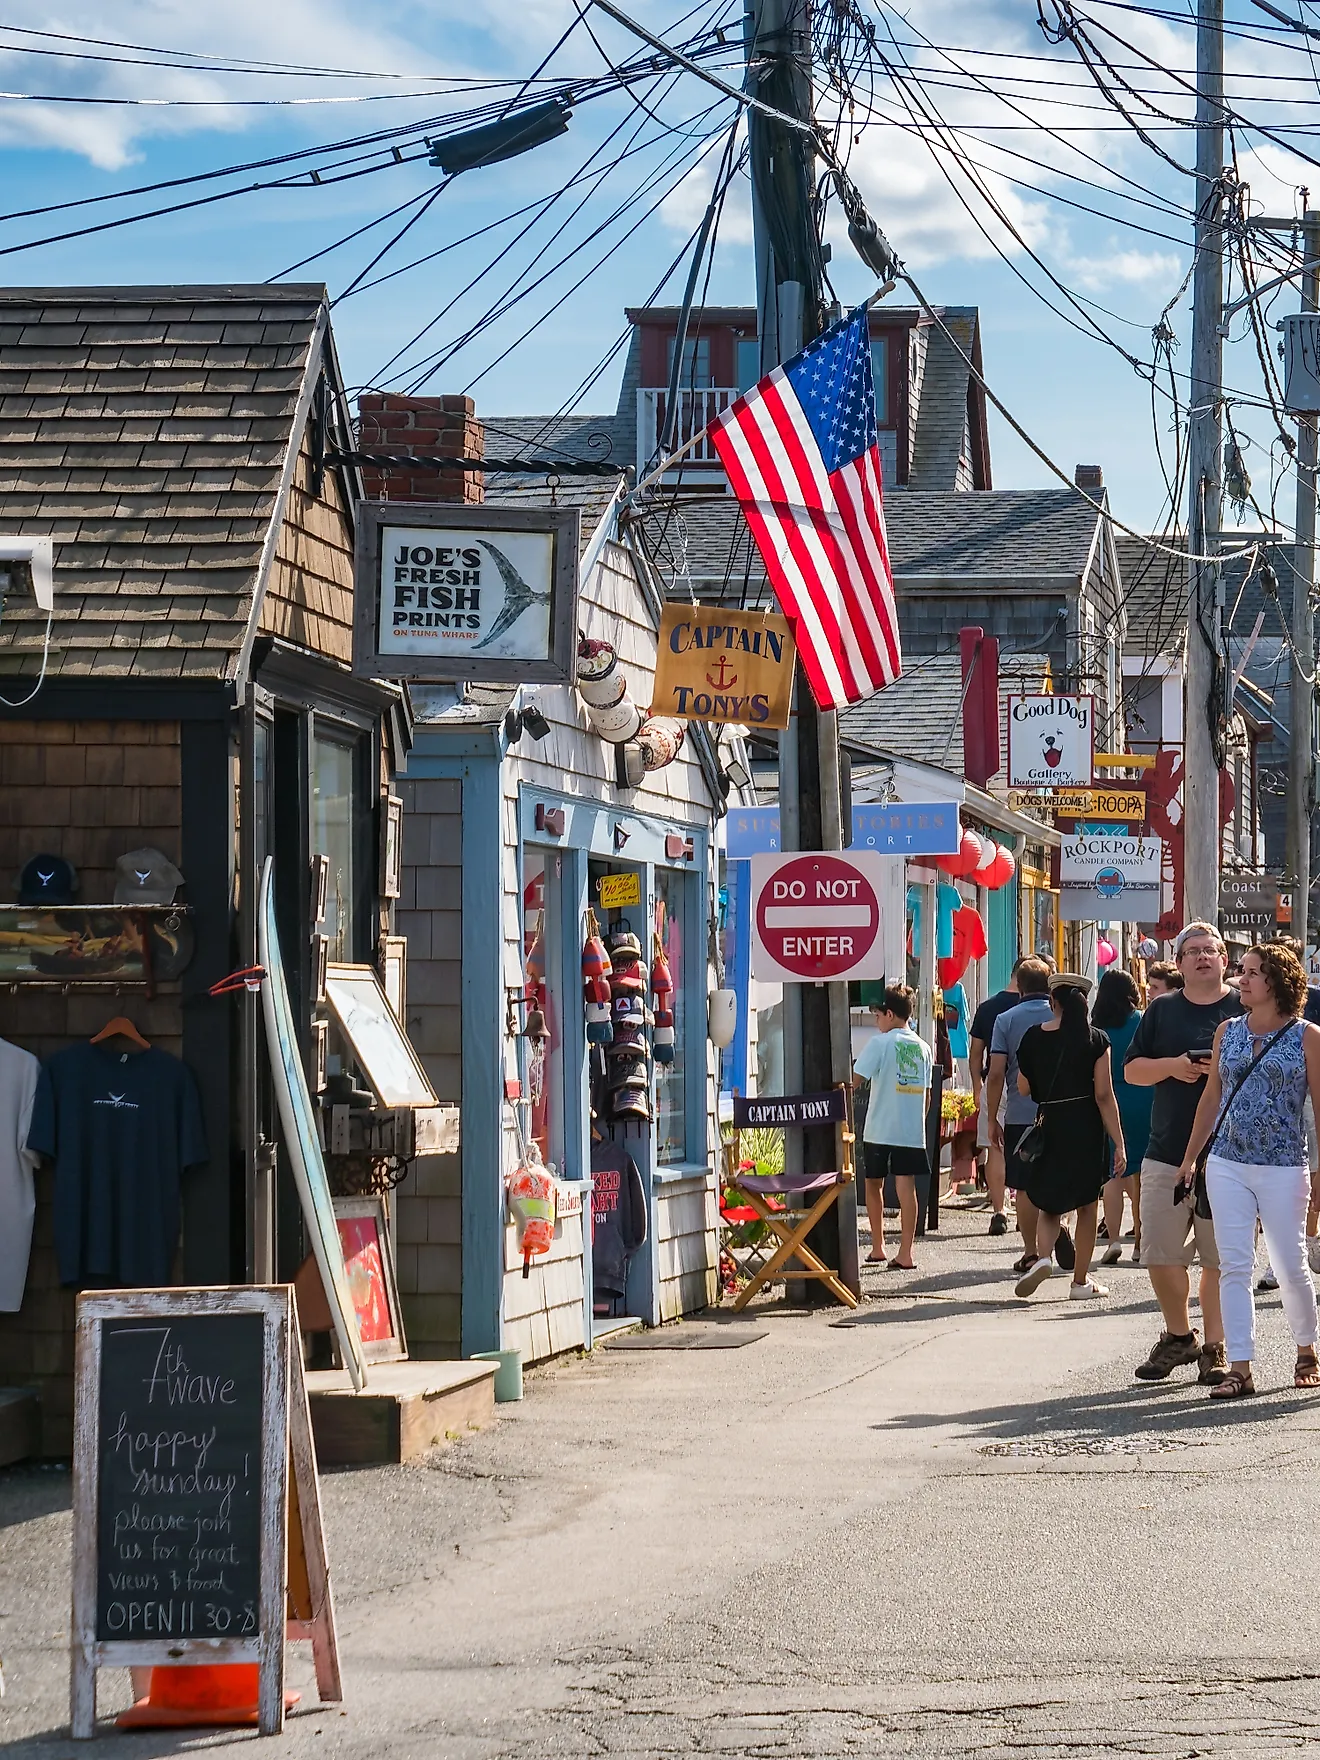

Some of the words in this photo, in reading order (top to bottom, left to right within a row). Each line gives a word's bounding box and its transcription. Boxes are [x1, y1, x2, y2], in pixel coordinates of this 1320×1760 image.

[394, 546, 481, 568] JOE'S
[394, 567, 480, 585] FRESH
[394, 586, 480, 610] FISH
[393, 612, 480, 629] PRINTS
[393, 629, 408, 637] ON
[442, 631, 479, 639] WHARF
[670, 622, 785, 663] CAPTAIN
[673, 686, 769, 722] TONY'S
[1013, 698, 1054, 721] Good
[1058, 698, 1088, 729] Dog
[1028, 768, 1072, 780] Gallery
[1016, 795, 1042, 806] DOGS
[1044, 796, 1087, 807] WELCOME!
[856, 814, 945, 831] TORIES
[1063, 840, 1160, 861] ROCKPORT
[1074, 857, 1106, 865] CANDLE
[1106, 858, 1145, 866] COMPANY
[773, 880, 806, 899] DO
[816, 879, 861, 898] NOT
[1221, 880, 1261, 893] Coast
[1235, 897, 1248, 909] &
[1283, 896, 1289, 906] 4
[1224, 913, 1272, 927] ountry
[782, 936, 854, 956] ENTER
[748, 1104, 796, 1122] CAPTAIN
[801, 1100, 830, 1120] TONY
[110, 1327, 190, 1404] 7th
[108, 1411, 216, 1470] happy
[113, 1502, 188, 1546] please
[120, 1543, 142, 1559] us
[153, 1534, 178, 1560] for
[189, 1543, 239, 1572] great
[186, 1568, 234, 1594] food
[107, 1599, 172, 1632] OPEN
